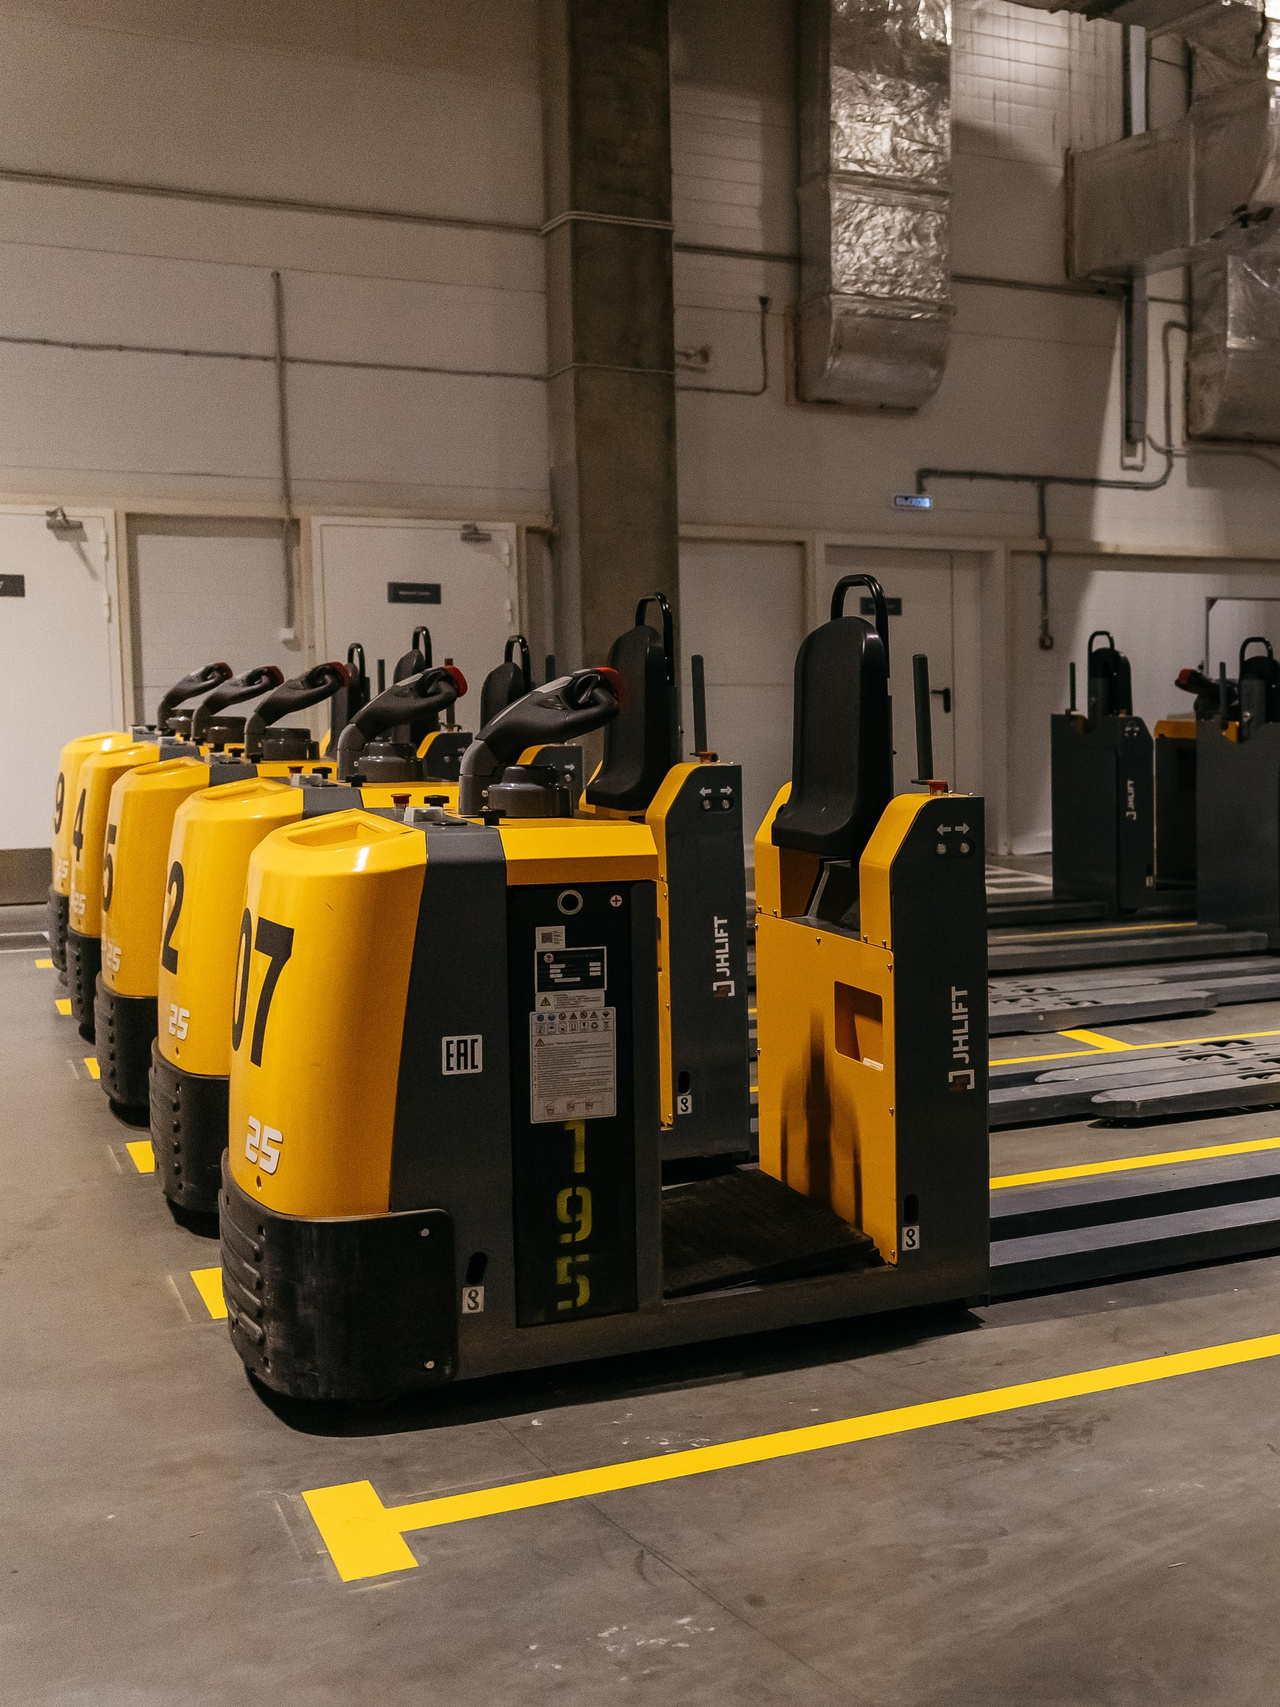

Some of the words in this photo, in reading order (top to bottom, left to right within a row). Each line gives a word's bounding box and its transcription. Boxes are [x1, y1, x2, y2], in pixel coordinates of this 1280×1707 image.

[54, 772, 64, 835] 9
[73, 788, 86, 862] 4
[161, 861, 185, 976] 2
[713, 916, 730, 977] JHLIFT
[232, 907, 295, 1068] 07
[168, 1003, 190, 1040] 25
[951, 986, 970, 1064] JHLIFT
[446, 1039, 479, 1071] EAC
[245, 1115, 283, 1174] 25
